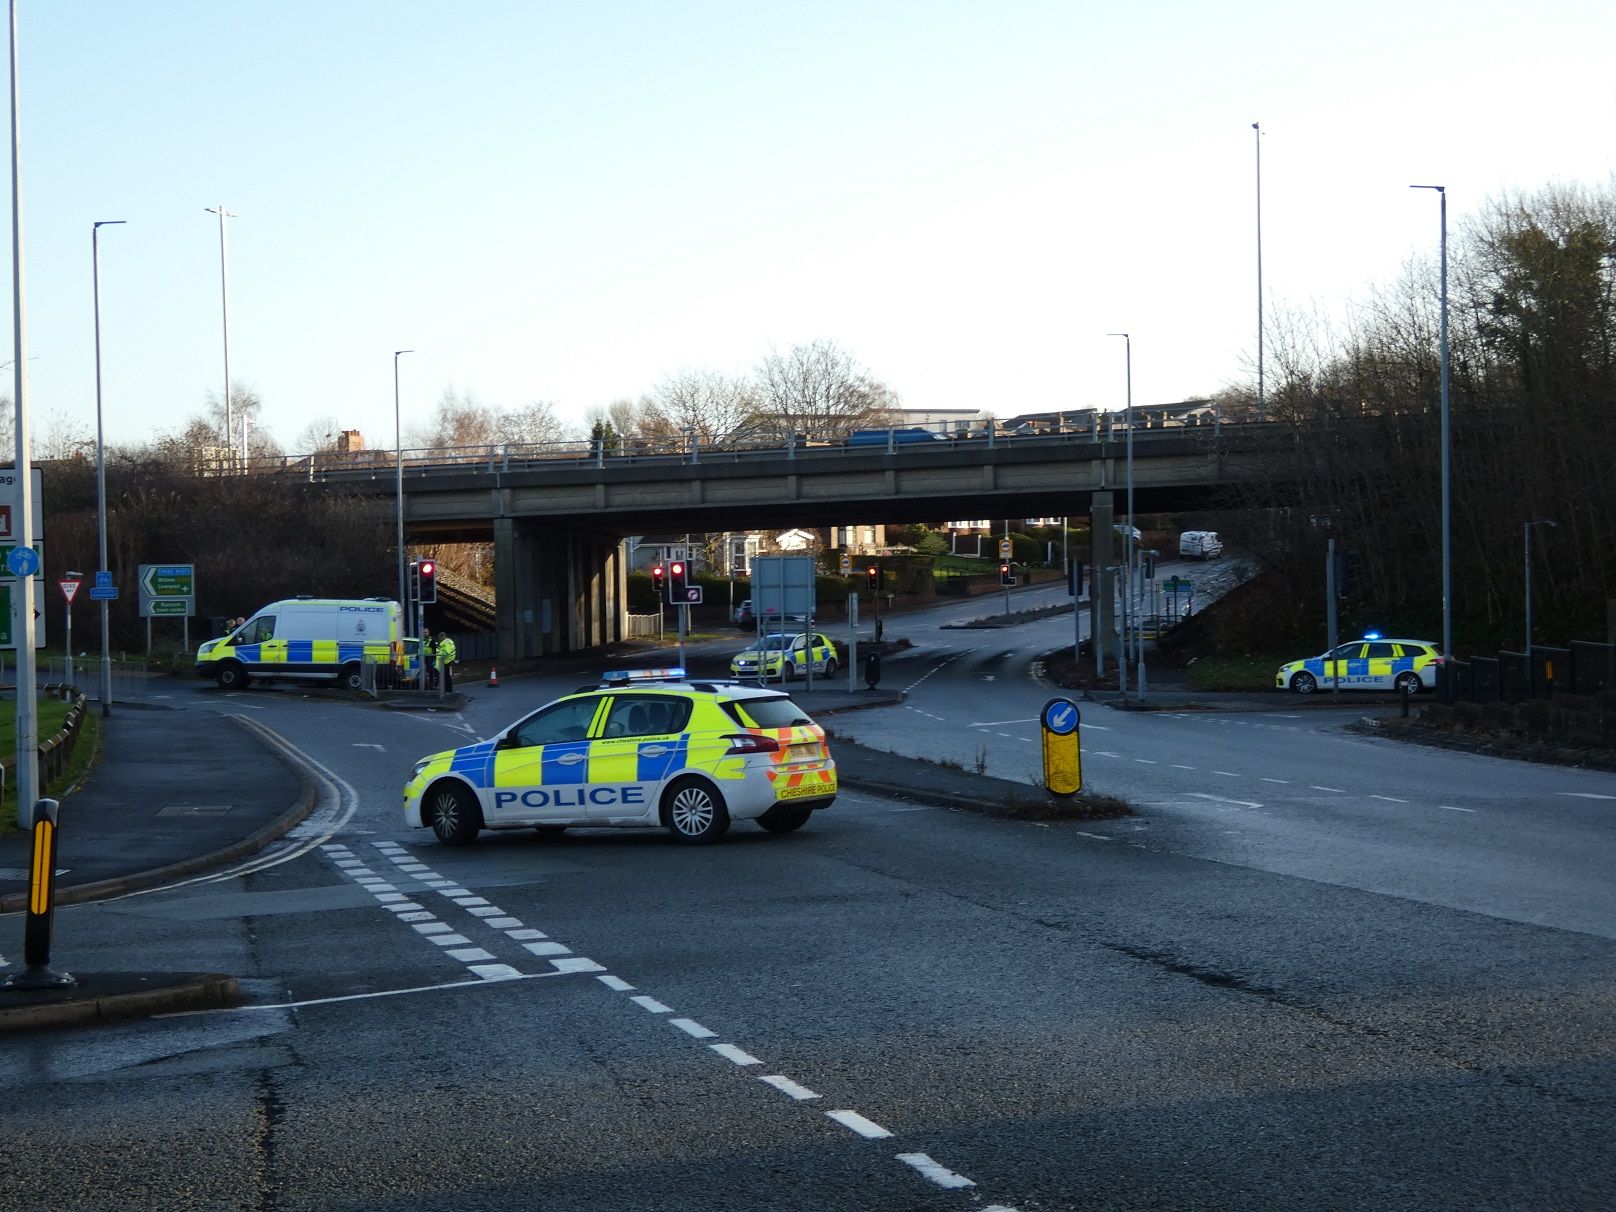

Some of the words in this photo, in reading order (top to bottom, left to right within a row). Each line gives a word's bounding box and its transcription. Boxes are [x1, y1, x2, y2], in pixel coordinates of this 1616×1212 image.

[494, 786, 645, 809] POLICE
[780, 785, 816, 799] CHESHIRE
[817, 783, 836, 793] POLICE
